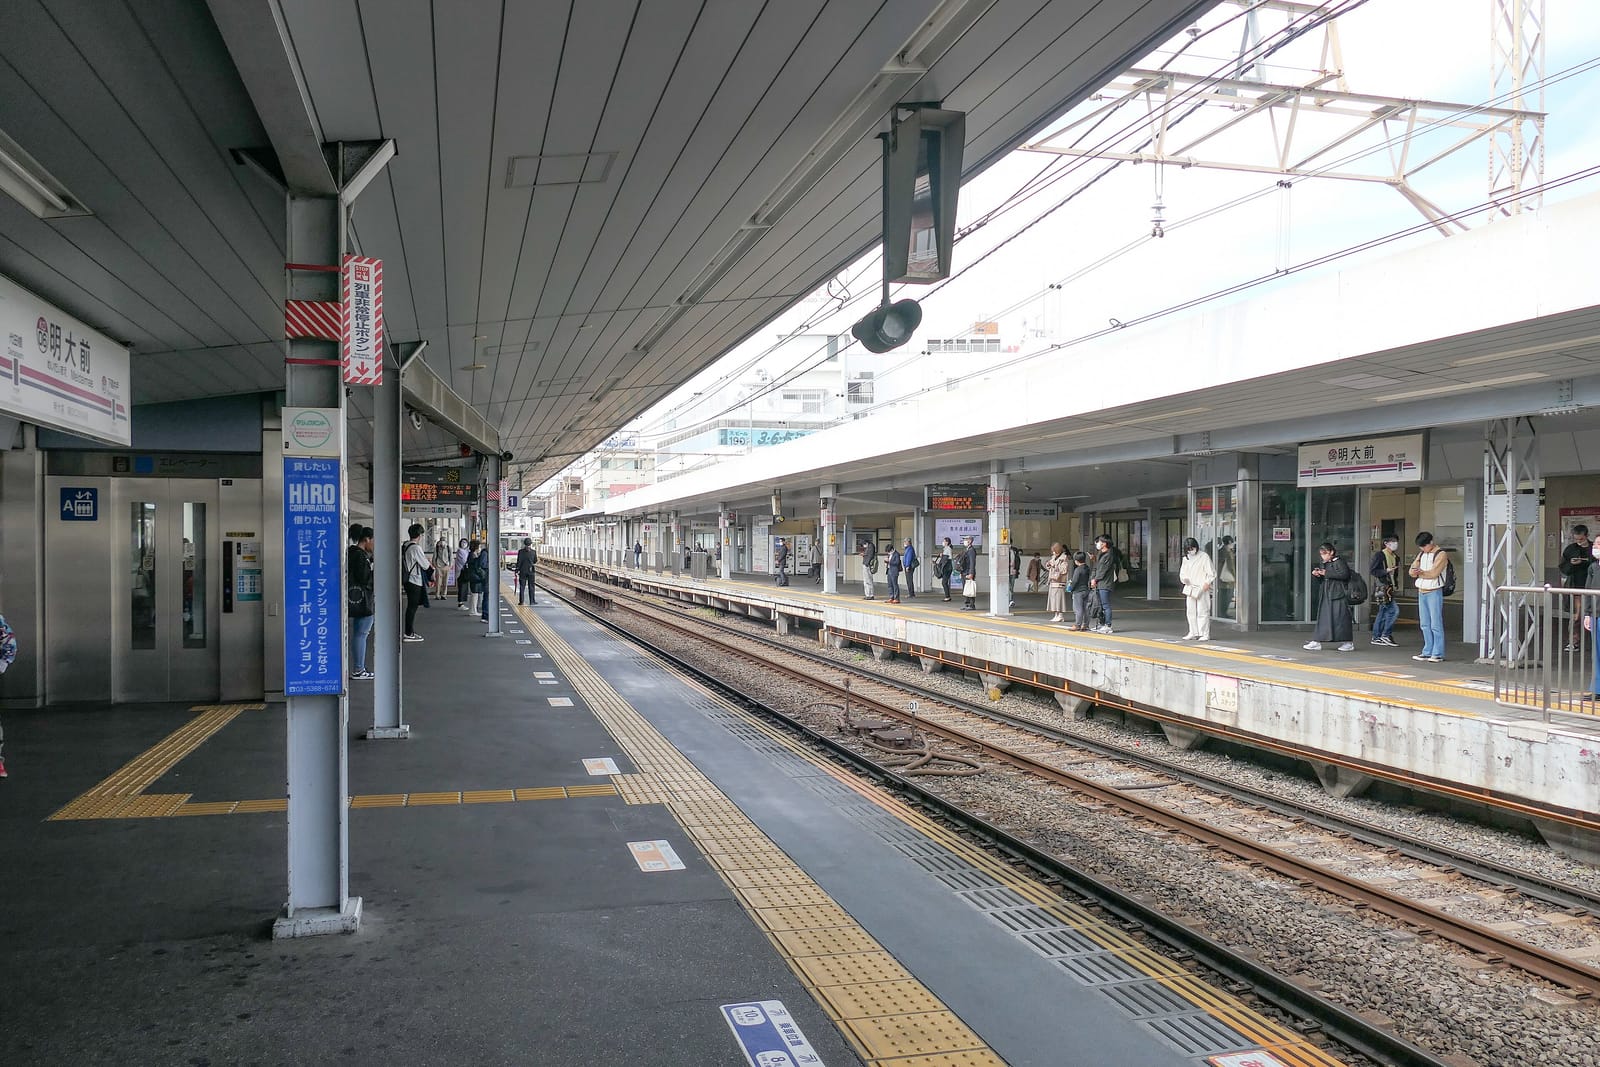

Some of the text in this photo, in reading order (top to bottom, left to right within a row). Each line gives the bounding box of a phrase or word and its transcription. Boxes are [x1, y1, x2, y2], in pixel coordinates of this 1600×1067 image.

[354, 282, 370, 352] 列車非常停止ボタン
[50, 322, 91, 375] 明大前
[1338, 445, 1374, 461] 明大前
[159, 458, 217, 466] エレベーター
[293, 462, 331, 472] 貸したい
[289, 481, 336, 504] HIRO
[63, 500, 74, 511] A
[289, 504, 336, 512] CORPORATION
[293, 515, 331, 525] 借りたい
[316, 529, 328, 675] アパート・マンションのことなら
[779, 1022, 804, 1047] 乗車位置
